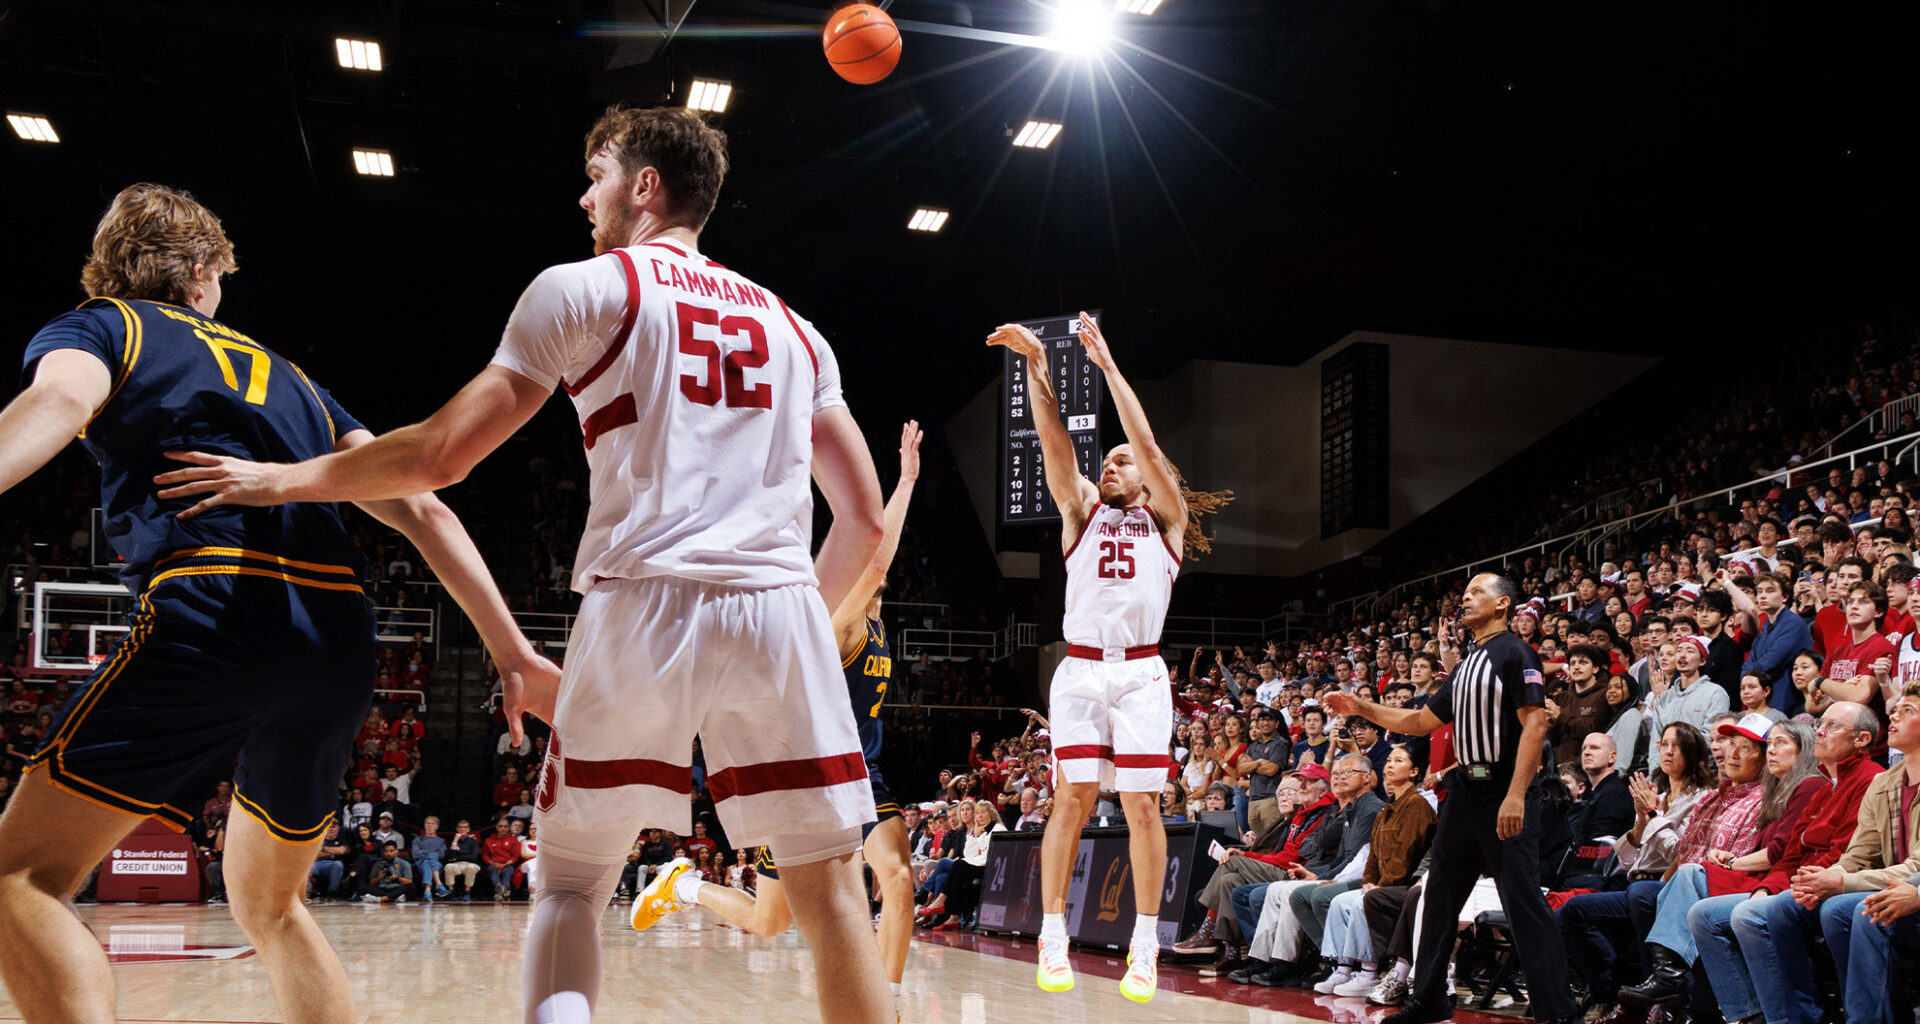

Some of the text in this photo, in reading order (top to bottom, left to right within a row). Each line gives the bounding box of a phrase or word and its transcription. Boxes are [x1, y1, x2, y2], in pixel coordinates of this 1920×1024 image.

[651, 258, 770, 310] CAMMANN
[1056, 340, 1072, 349] REB
[676, 301, 772, 409] 52
[1015, 359, 1021, 368] 1
[1062, 354, 1067, 363] 1
[193, 328, 271, 405] 17
[1014, 364, 1090, 380] 2 6 0
[1012, 376, 1090, 393] 11 3 0
[1011, 389, 1089, 406] 25 0 1
[1011, 402, 1089, 418] 52 2 1
[1075, 417, 1089, 428] 13
[1011, 441, 1024, 449] NO.
[1079, 434, 1093, 443] FLS
[1013, 449, 1089, 465] 2 3 1
[1014, 462, 1089, 477] 7 2 1
[1011, 478, 1042, 489] 10 4
[1011, 490, 1042, 501] 17 0
[1010, 502, 1042, 514] 22 0
[1098, 541, 1136, 579] 25
[869, 681, 888, 719] 2
[123, 850, 188, 859] Stanford Federal
[116, 863, 183, 872] CREDIT UNION
[990, 856, 1008, 892] 24
[1096, 856, 1130, 922] Cal
